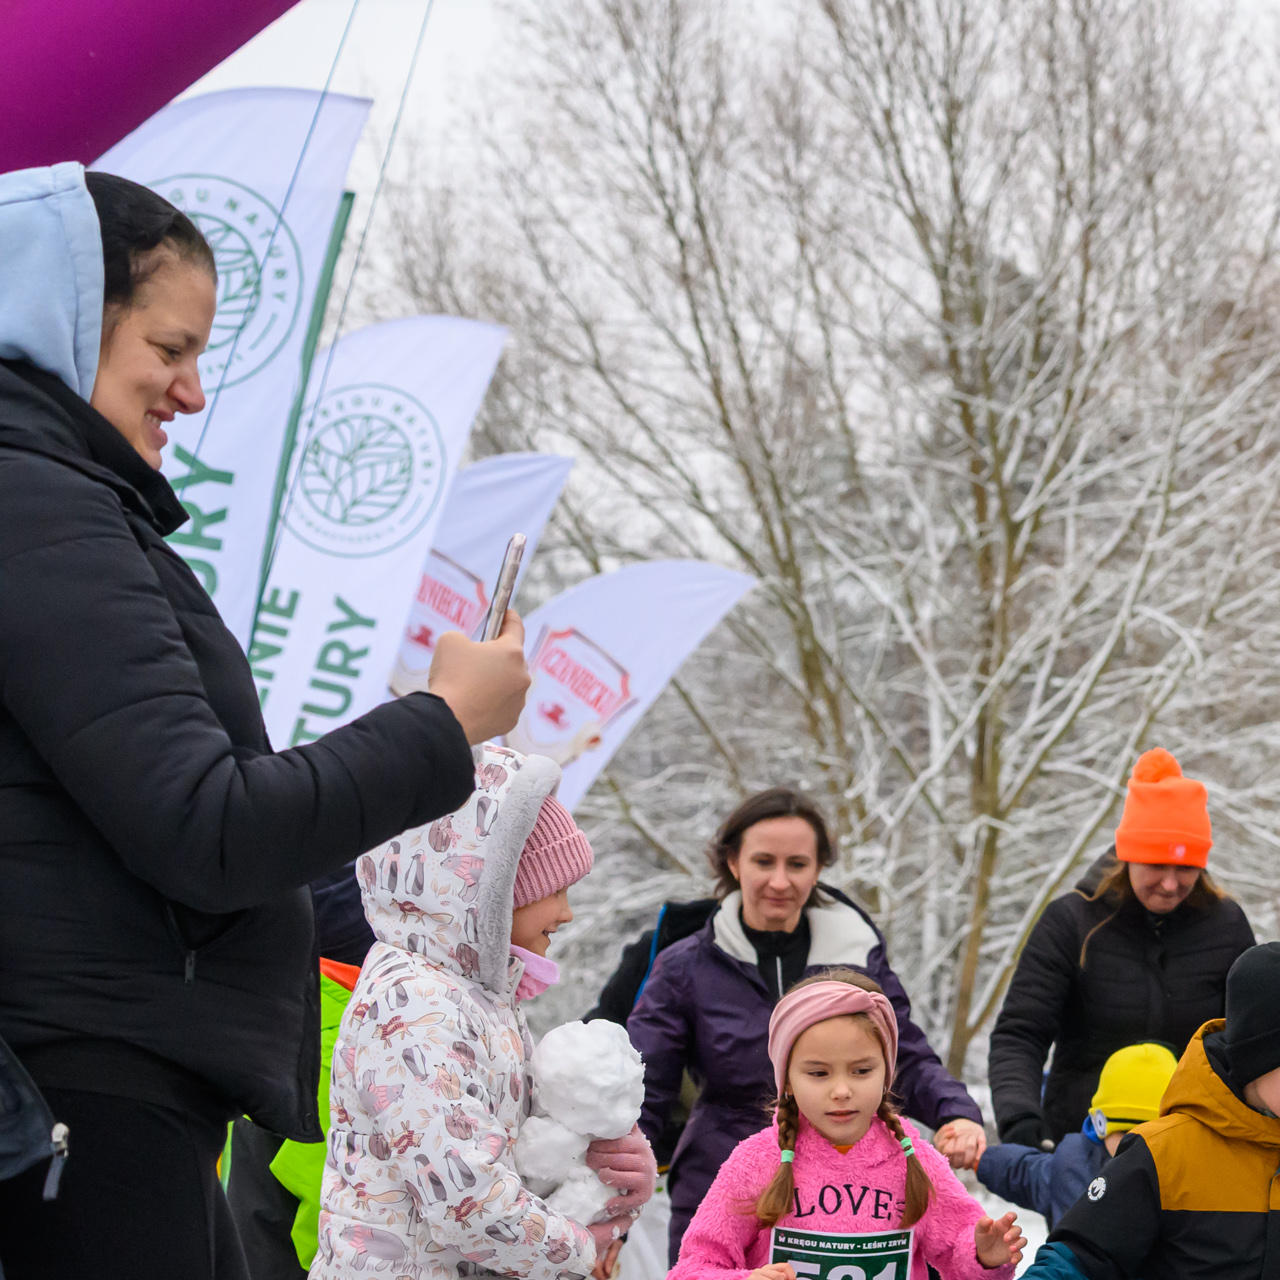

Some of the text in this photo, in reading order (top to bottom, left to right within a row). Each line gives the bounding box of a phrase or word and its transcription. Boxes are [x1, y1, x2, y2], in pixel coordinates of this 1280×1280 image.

[794, 1184, 893, 1221] LOVE
[778, 1236, 786, 1244] W
[787, 1237, 818, 1248] KRĘGU
[819, 1241, 855, 1250] NATURY
[862, 1240, 887, 1250] LEŚNY
[888, 1238, 907, 1247] ZRYW
